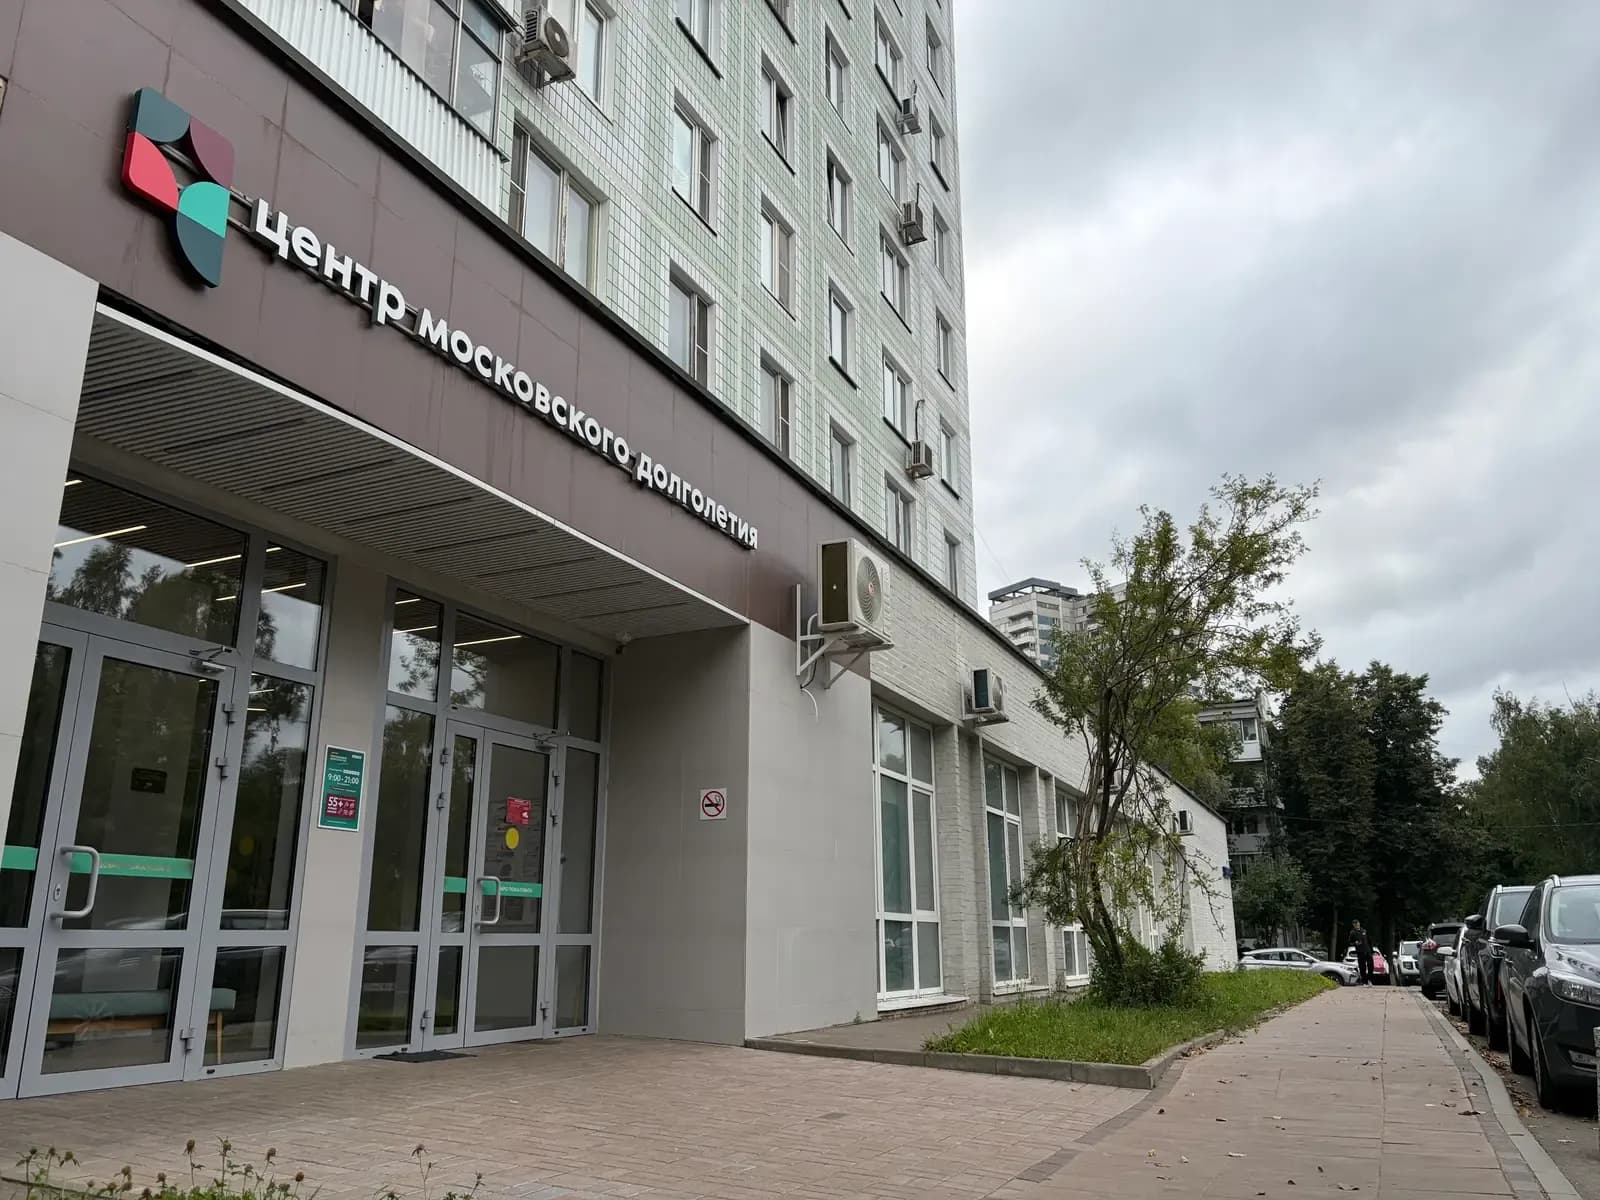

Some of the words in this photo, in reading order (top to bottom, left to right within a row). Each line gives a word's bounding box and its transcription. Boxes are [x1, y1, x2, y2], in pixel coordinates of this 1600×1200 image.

[255, 199, 406, 325] центр
[419, 309, 630, 465] московского
[636, 453, 759, 550] долголетия
[328, 797, 343, 808] 55+
